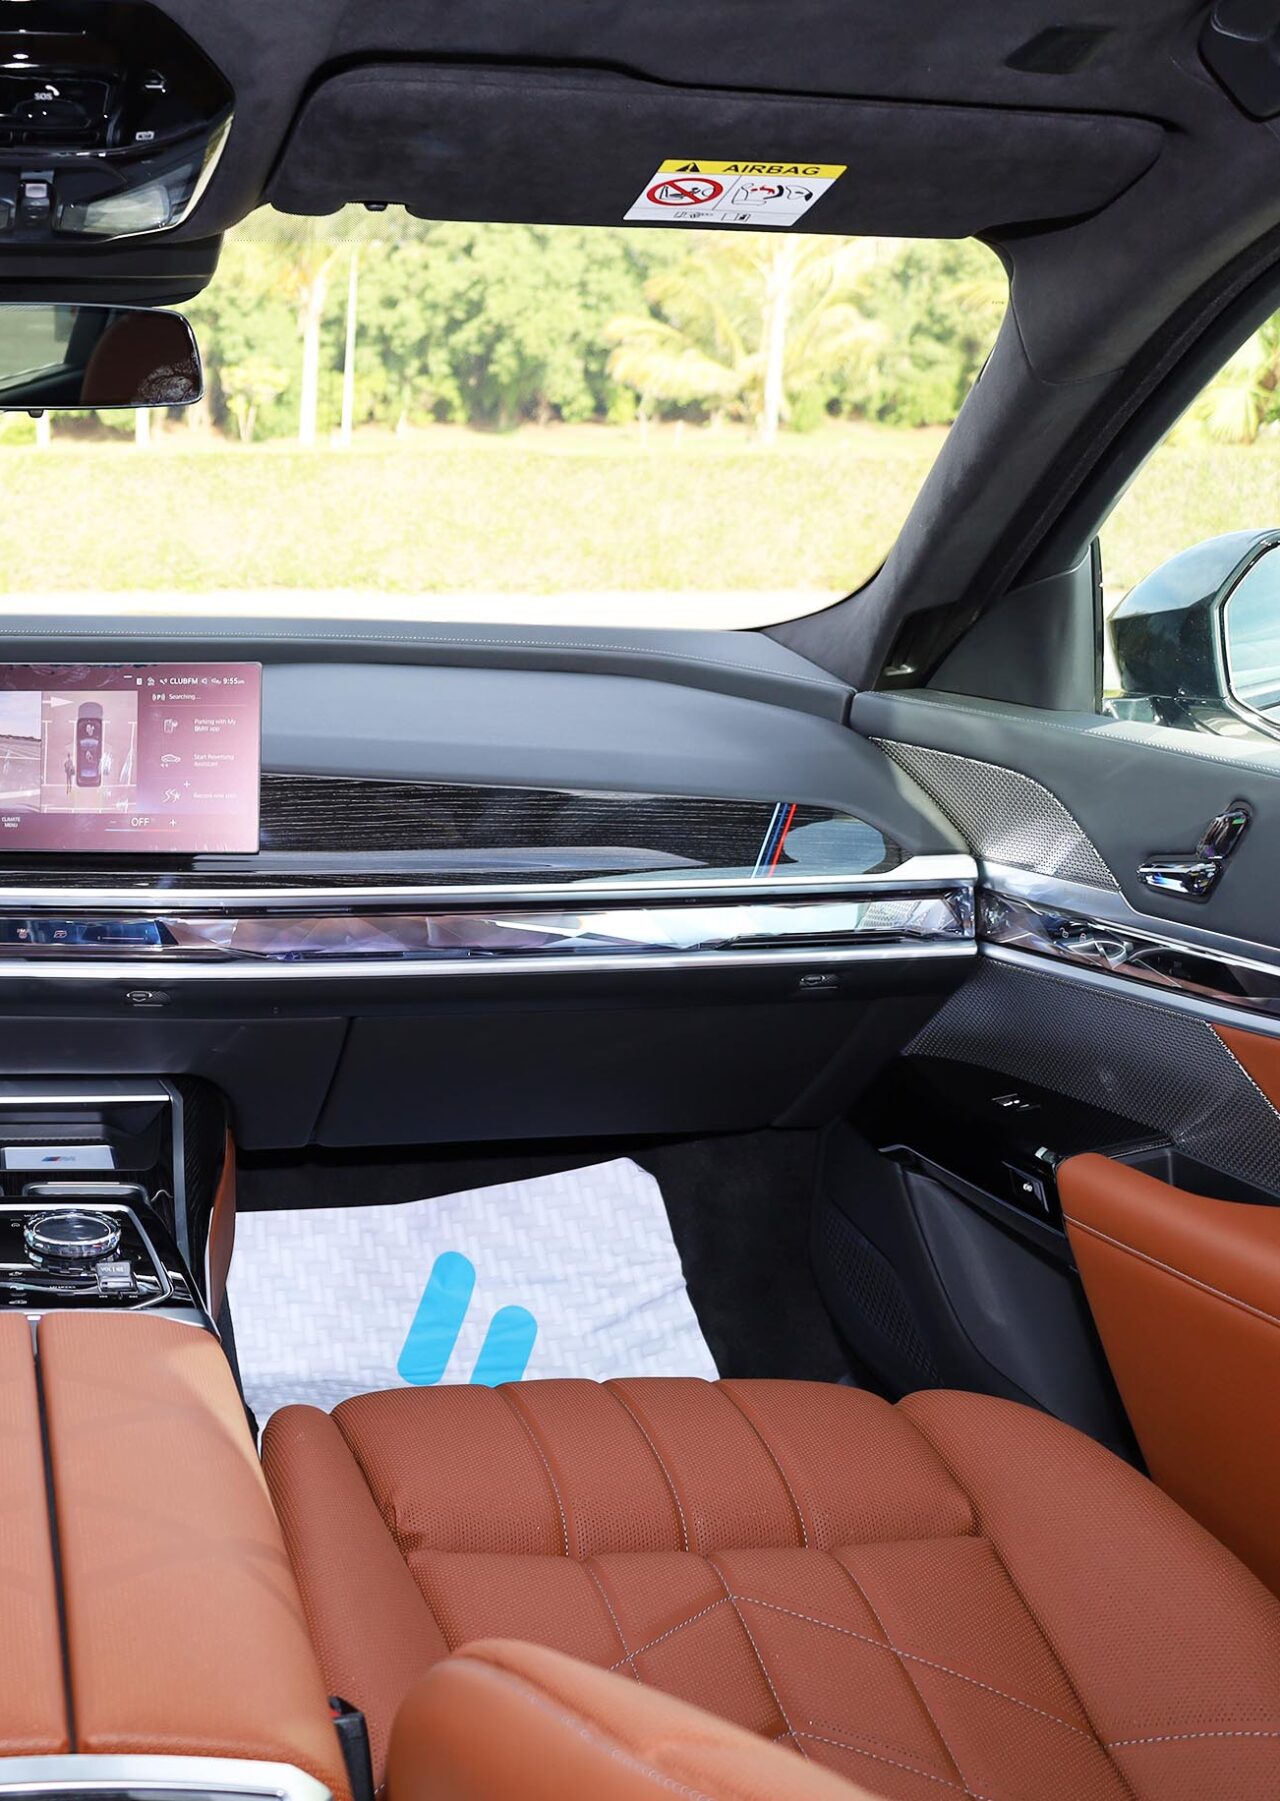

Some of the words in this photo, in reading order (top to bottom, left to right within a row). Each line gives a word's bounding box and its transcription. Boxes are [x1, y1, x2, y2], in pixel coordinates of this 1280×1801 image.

[33, 92, 53, 101] SOS
[722, 163, 821, 176] AIRBAG
[169, 677, 199, 685] CLUBFM
[130, 817, 150, 827] OFF
